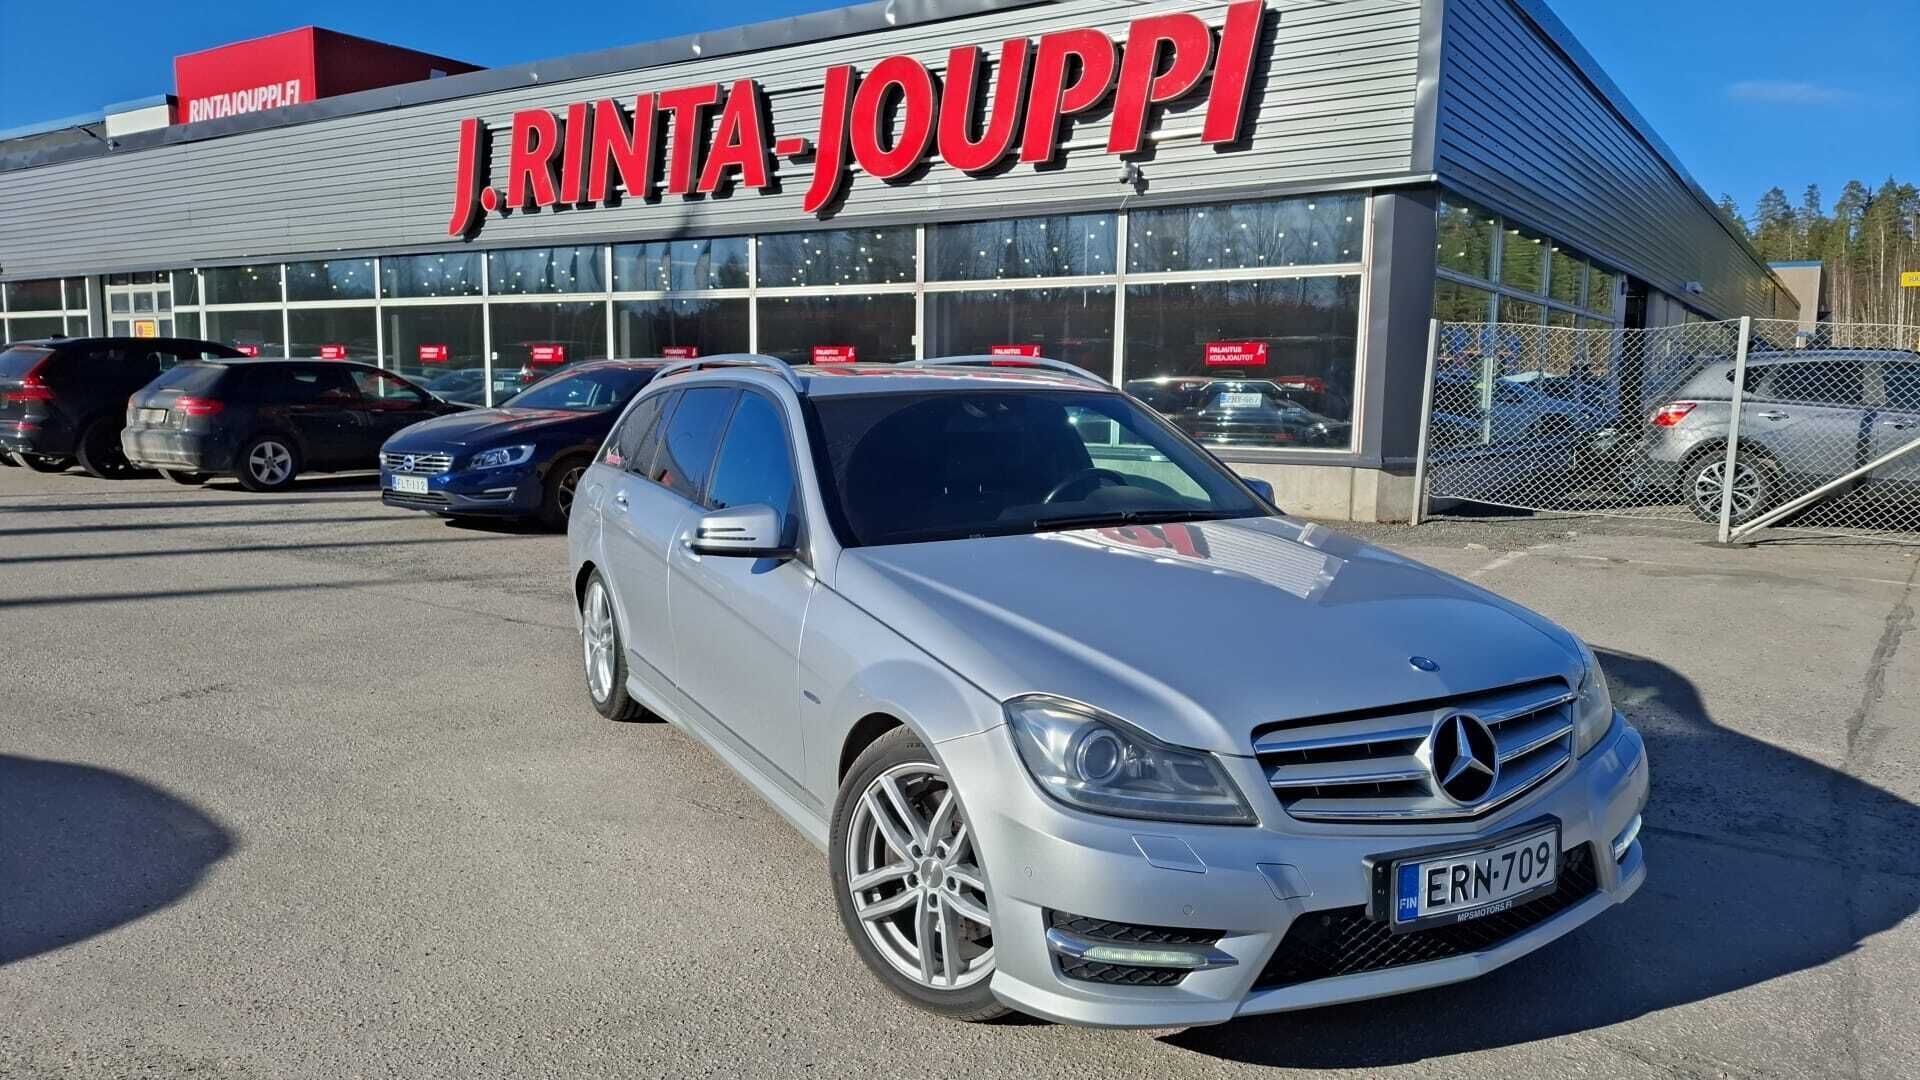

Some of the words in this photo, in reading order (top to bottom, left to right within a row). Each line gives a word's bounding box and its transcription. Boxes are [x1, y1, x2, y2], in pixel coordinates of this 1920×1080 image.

[189, 79, 300, 123] RINTAJOUPPI.FI
[1425, 841, 1551, 909] ERN-709
[1399, 896, 1418, 910] FIN
